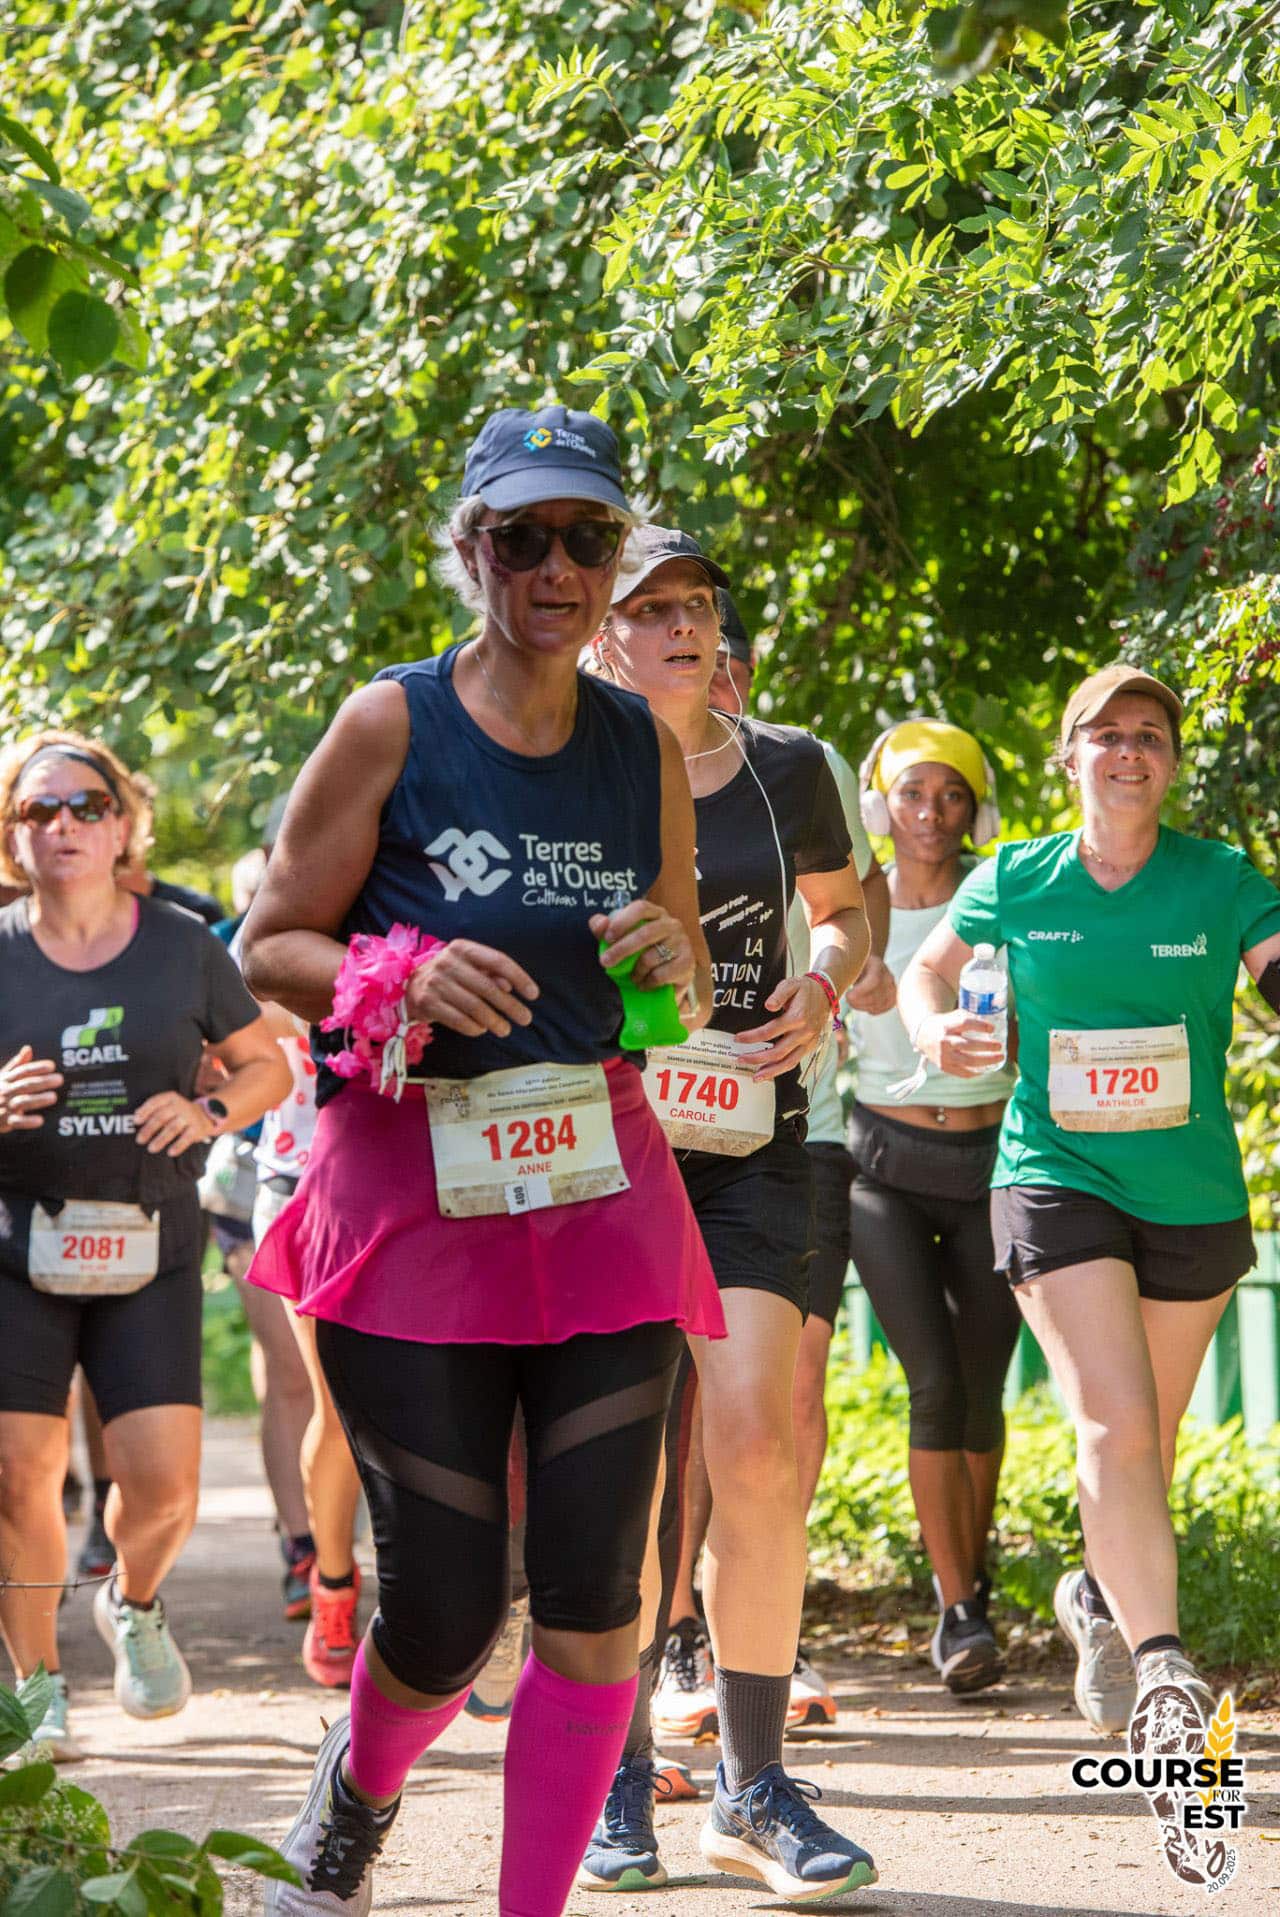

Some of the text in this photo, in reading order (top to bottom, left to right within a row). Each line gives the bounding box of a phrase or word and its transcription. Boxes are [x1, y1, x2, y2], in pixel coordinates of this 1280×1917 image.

[555, 428, 585, 443] Terres
[519, 834, 603, 861] Terres
[523, 862, 638, 891] de l'Ouest
[522, 888, 577, 906] Cultivons
[745, 937, 764, 957] LA
[1028, 931, 1070, 941] CRAFT
[1150, 944, 1207, 957] TERRENA
[711, 962, 762, 984] ATION
[713, 988, 757, 1010] COLE
[62, 1044, 129, 1067] SCAEL
[656, 1069, 739, 1111] 1740
[1086, 1066, 1158, 1095] 1720
[1097, 1098, 1146, 1107] MATHILDE
[58, 1114, 136, 1136] SYLVIE
[669, 1107, 717, 1124] CAROLE
[482, 1114, 577, 1161] 1284
[517, 1162, 552, 1176] ANNE
[62, 1235, 126, 1260] 2081
